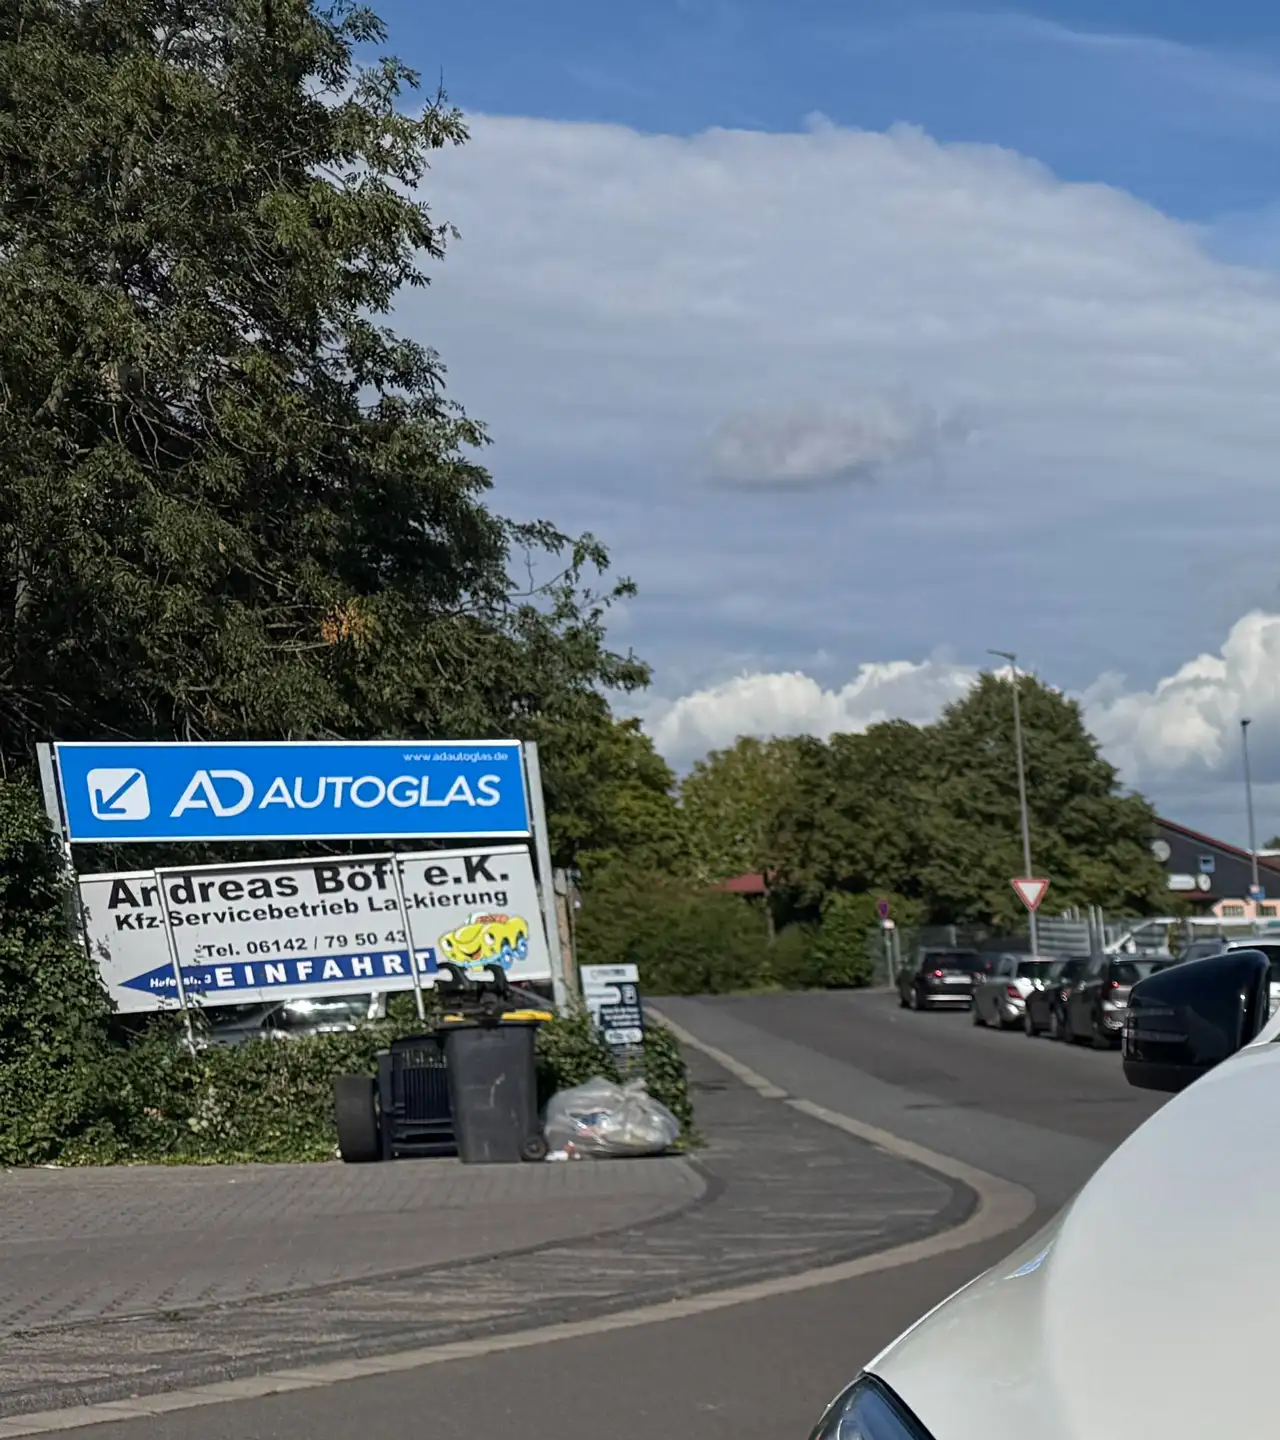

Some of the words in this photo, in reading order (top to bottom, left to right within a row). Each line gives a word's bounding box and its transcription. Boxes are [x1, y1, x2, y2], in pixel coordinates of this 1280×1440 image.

[402, 751, 509, 763] www.adautoglas.de
[169, 769, 254, 818] AD
[258, 774, 502, 809] AUTOGLAS
[108, 874, 299, 910] Andreas
[424, 855, 510, 885] e.K.
[115, 898, 359, 931] Kfz-Servicebetrieb
[369, 891, 509, 912] Lackierung
[203, 943, 240, 958] Tel.
[246, 938, 308, 954] 06142
[324, 934, 348, 949] 79
[355, 933, 379, 946] 50
[384, 929, 407, 944] 43
[215, 953, 431, 988] EINFAHRT
